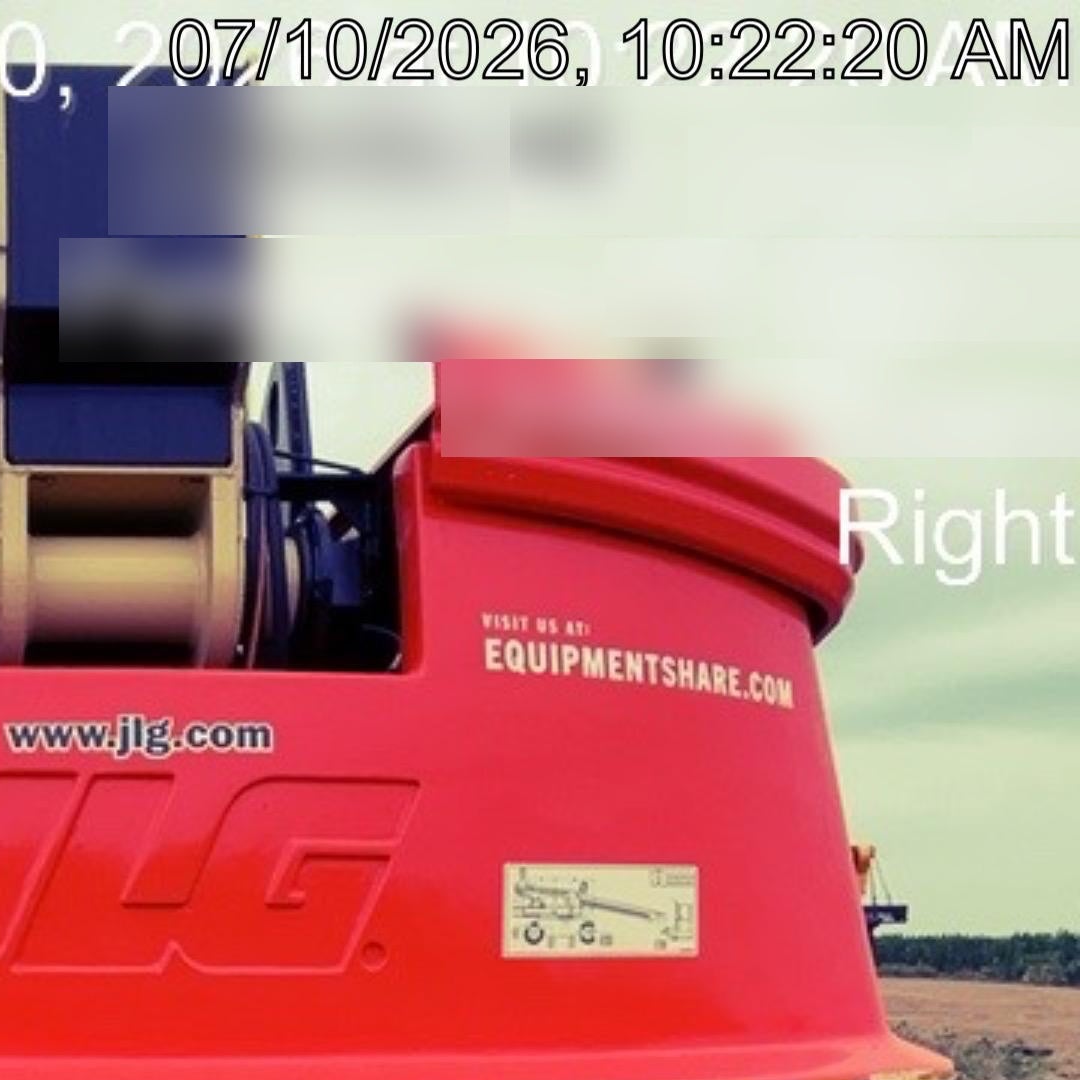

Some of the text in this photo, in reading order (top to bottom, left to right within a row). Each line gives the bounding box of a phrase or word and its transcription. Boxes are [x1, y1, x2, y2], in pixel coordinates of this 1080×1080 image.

[481, 612, 591, 637] VISIT US AT:
[484, 637, 795, 709] EQUIPMENTSHARE.COM
[5, 715, 273, 758] www.jlg.com
